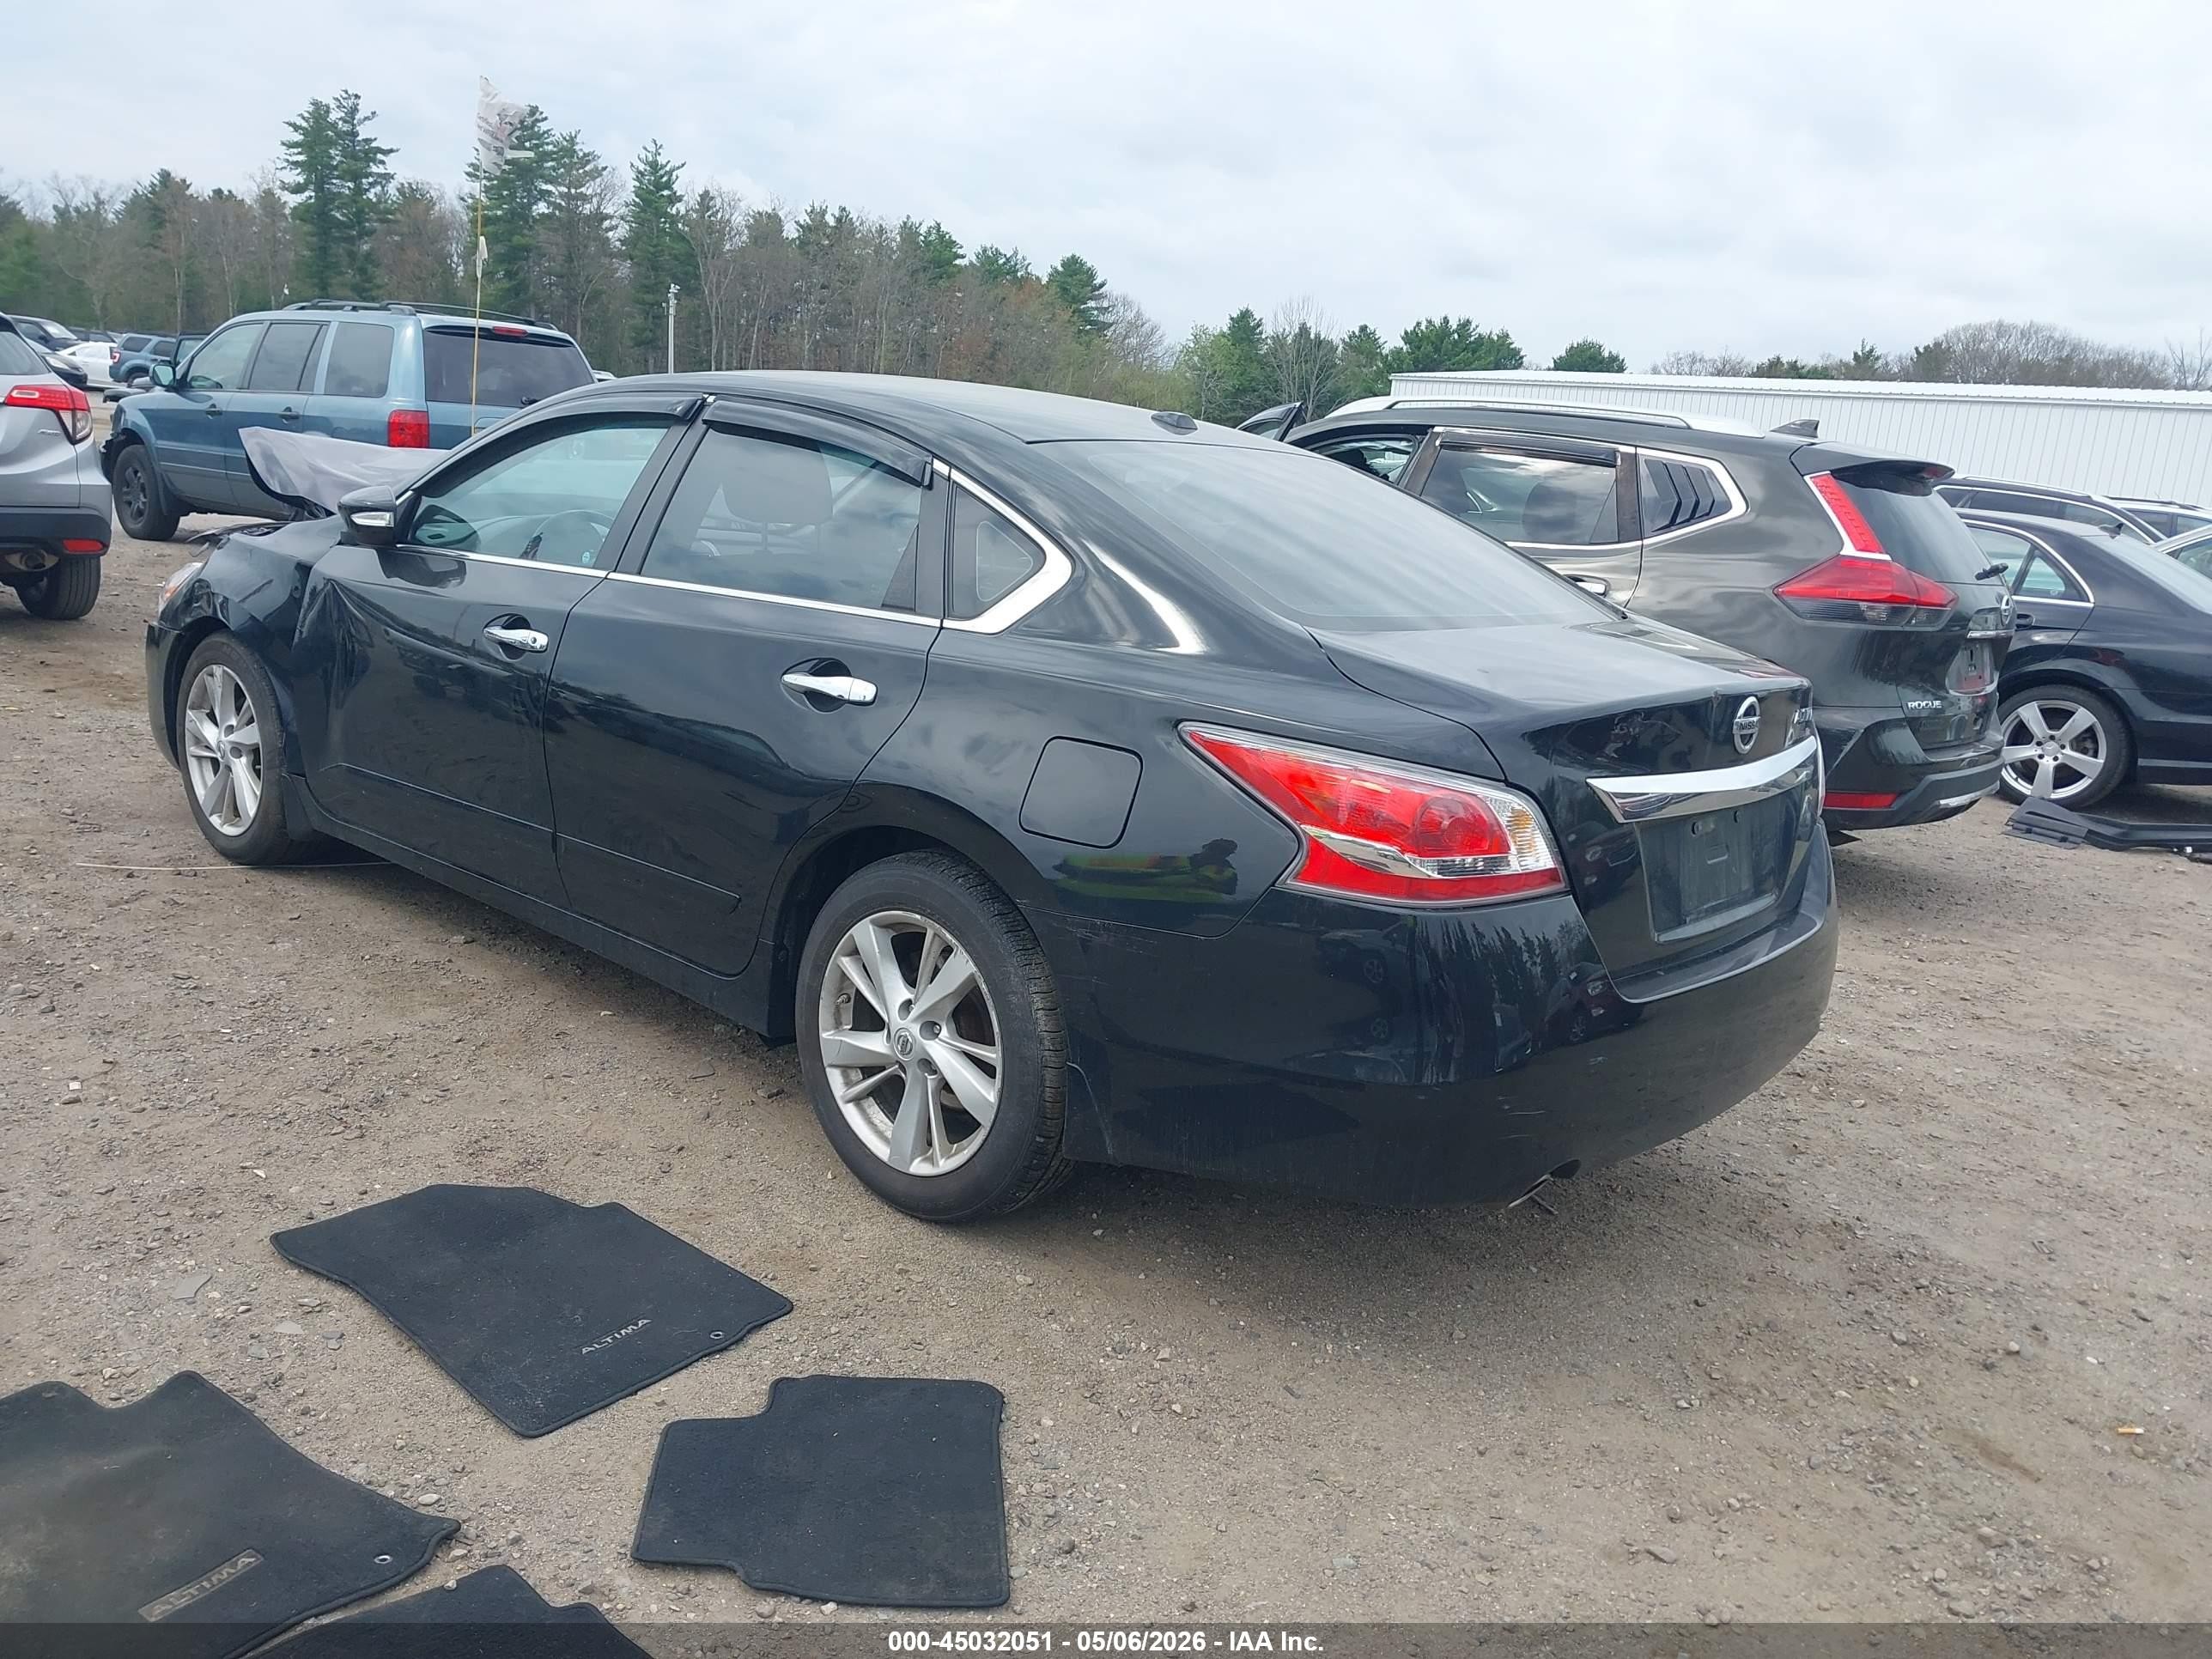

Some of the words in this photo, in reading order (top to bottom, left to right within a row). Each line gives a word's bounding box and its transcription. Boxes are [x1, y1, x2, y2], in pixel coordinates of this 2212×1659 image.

[1907, 700, 1942, 710] ROGUE
[581, 1319, 653, 1355] ALTIMA
[149, 1549, 258, 1618] ALTIMA
